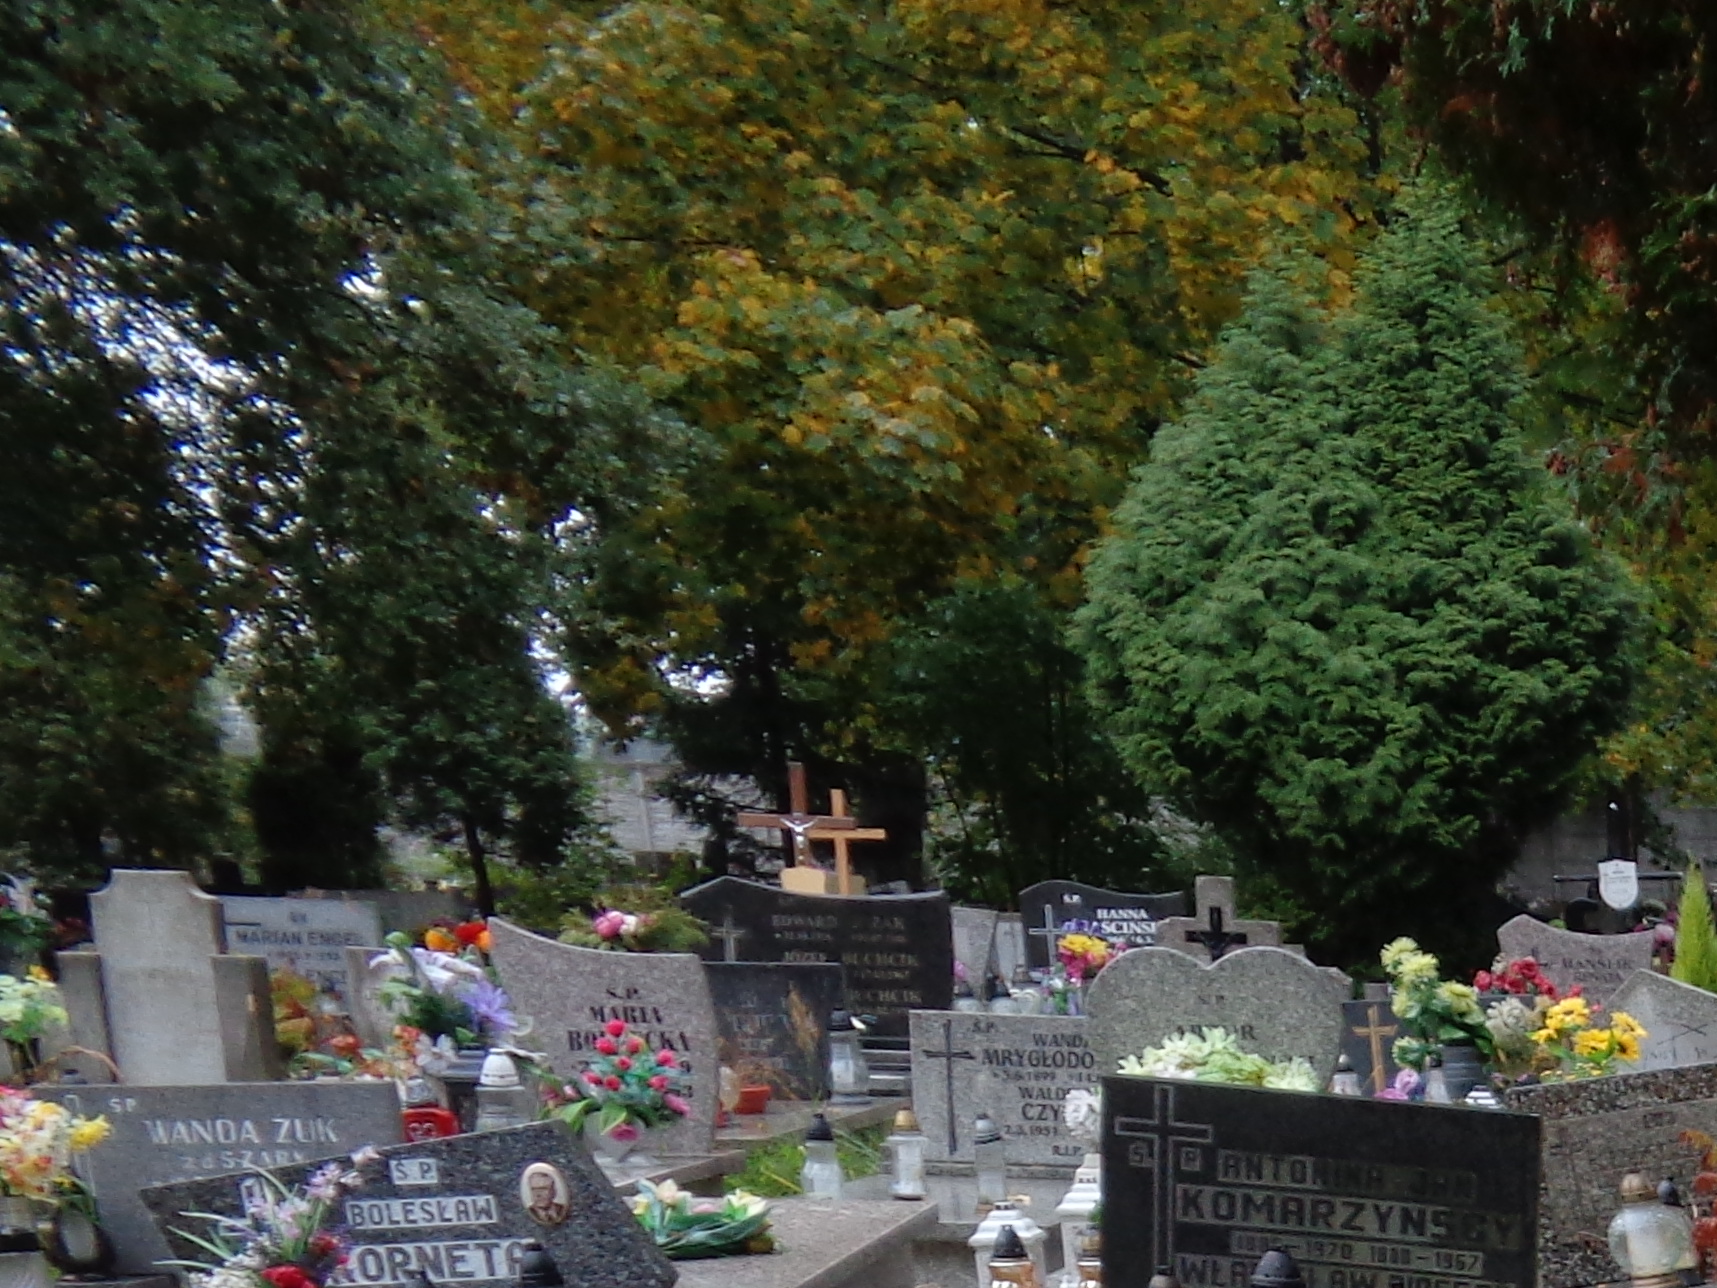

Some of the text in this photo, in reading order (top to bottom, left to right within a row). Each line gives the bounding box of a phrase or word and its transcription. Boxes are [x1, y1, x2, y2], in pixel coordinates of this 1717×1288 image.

[1095, 908, 1149, 920] HANNA
[589, 1006, 663, 1024] MARIA
[350, 1196, 494, 1228] BOLESŁAW
